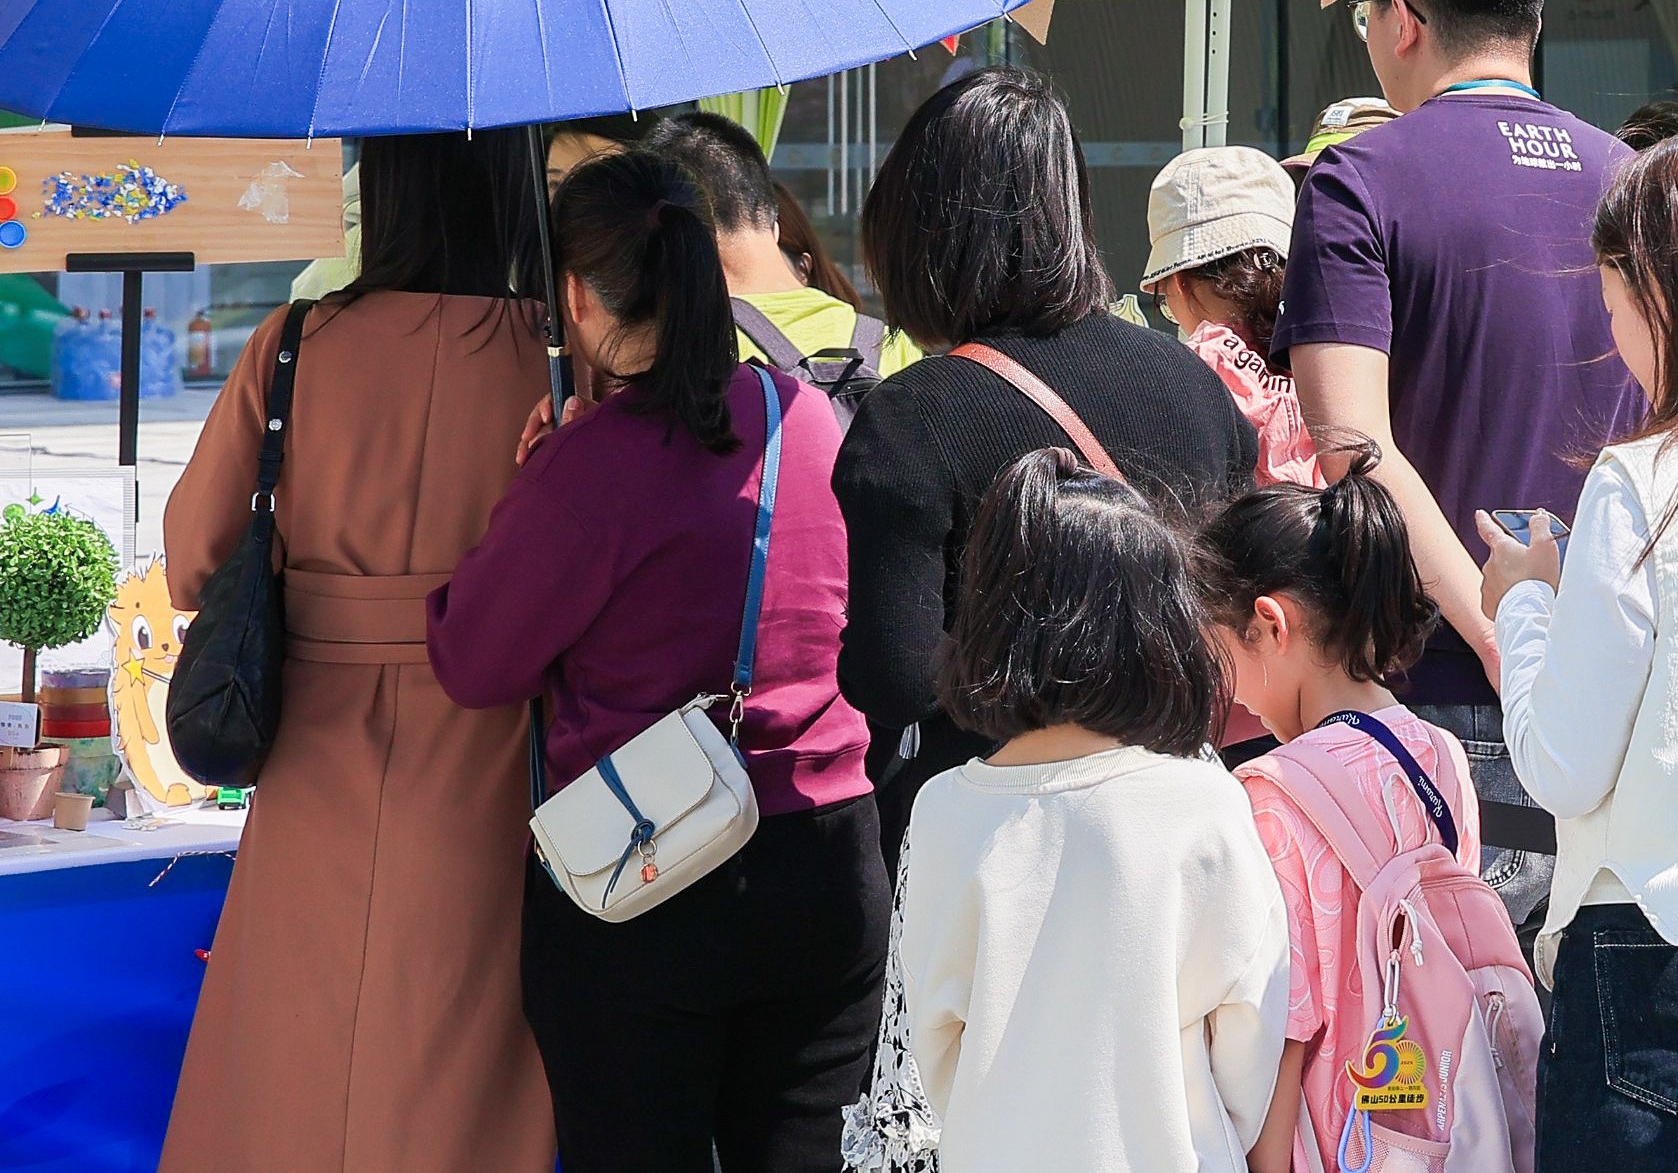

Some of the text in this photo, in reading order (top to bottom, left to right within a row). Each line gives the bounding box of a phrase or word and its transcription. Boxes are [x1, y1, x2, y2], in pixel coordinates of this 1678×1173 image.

[1497, 121, 1572, 143] EARTH
[1508, 137, 1578, 160] HOUR
[1417, 775, 1443, 818] Kuromi
[1438, 1049, 1452, 1083] JUNIOR
